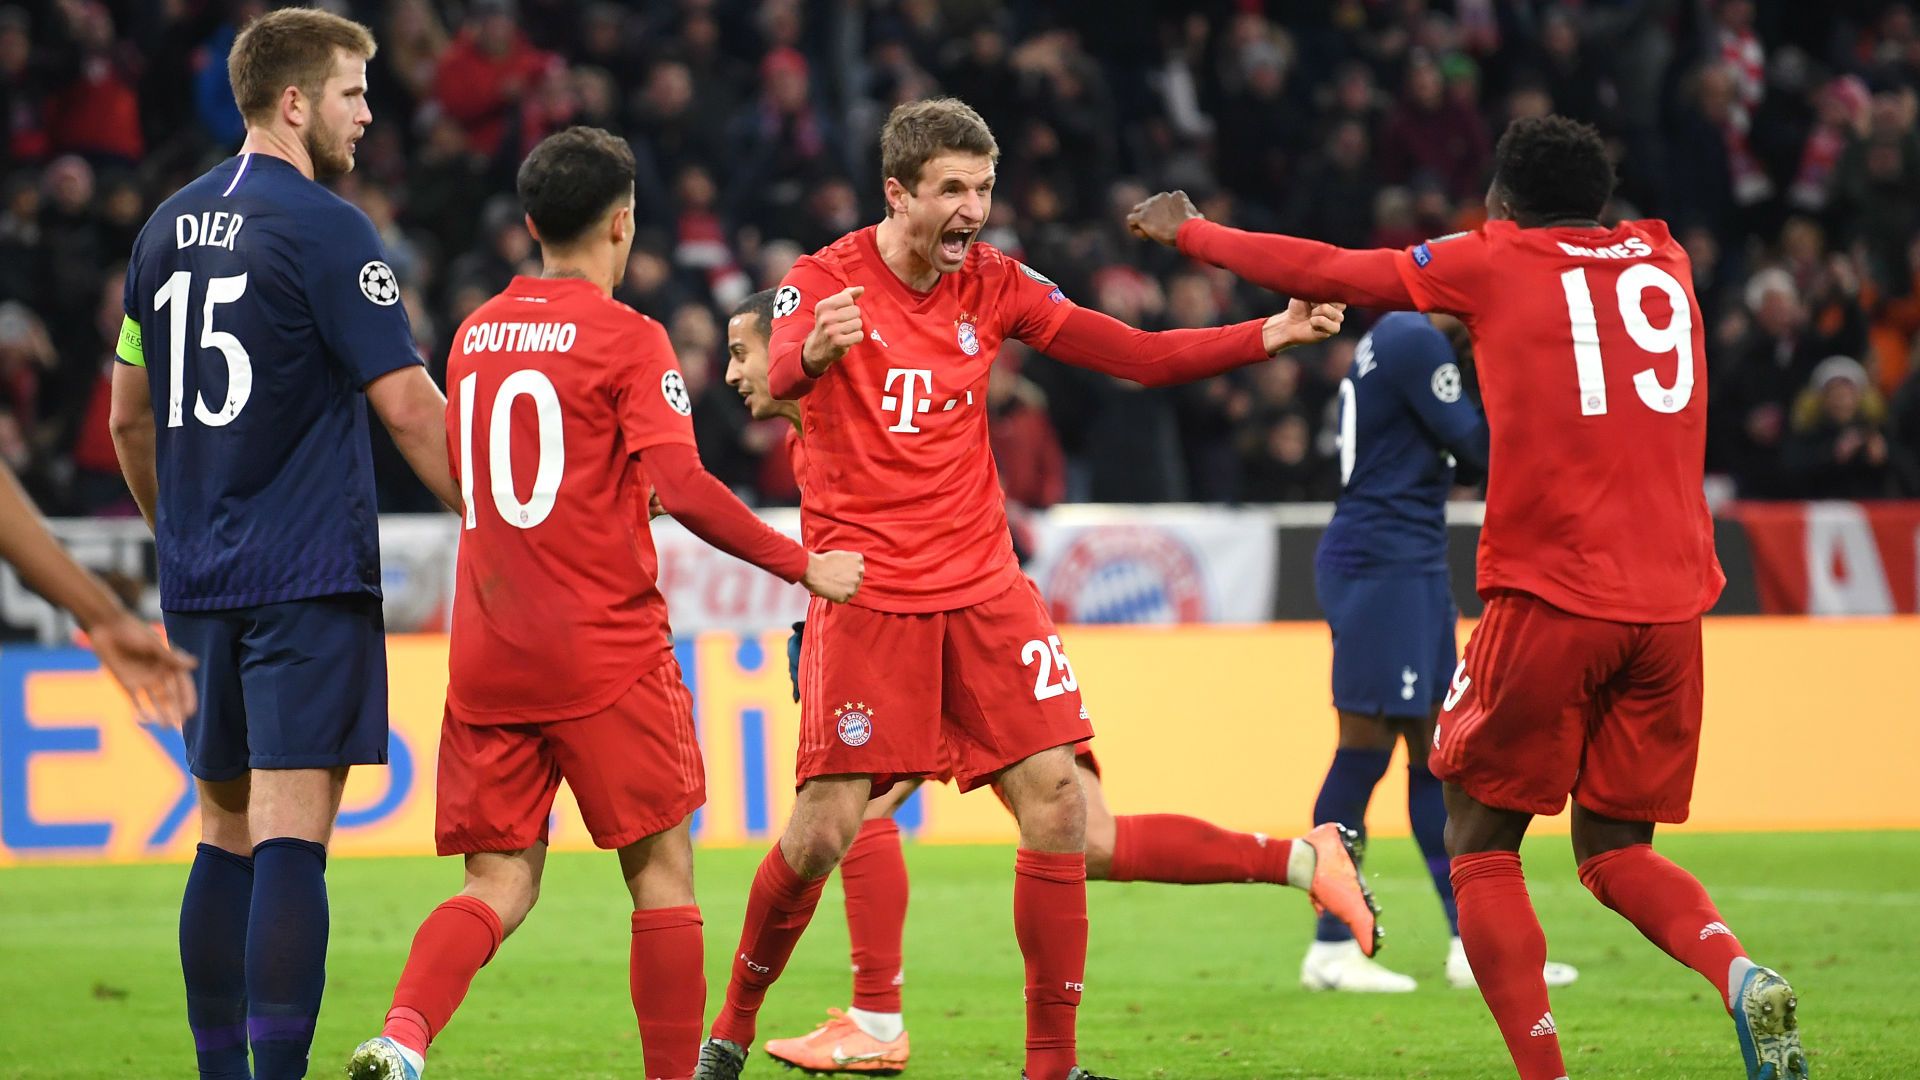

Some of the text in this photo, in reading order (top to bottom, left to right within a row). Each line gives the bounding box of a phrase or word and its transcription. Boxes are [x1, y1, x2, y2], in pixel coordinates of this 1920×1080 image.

[175, 211, 244, 251] DIER
[153, 271, 253, 428] 15
[463, 322, 577, 356] COUTINHO
[1560, 262, 1695, 417] 19
[459, 368, 565, 530] 10
[1021, 634, 1078, 701] 25
[1530, 1026, 1557, 1037] adid
